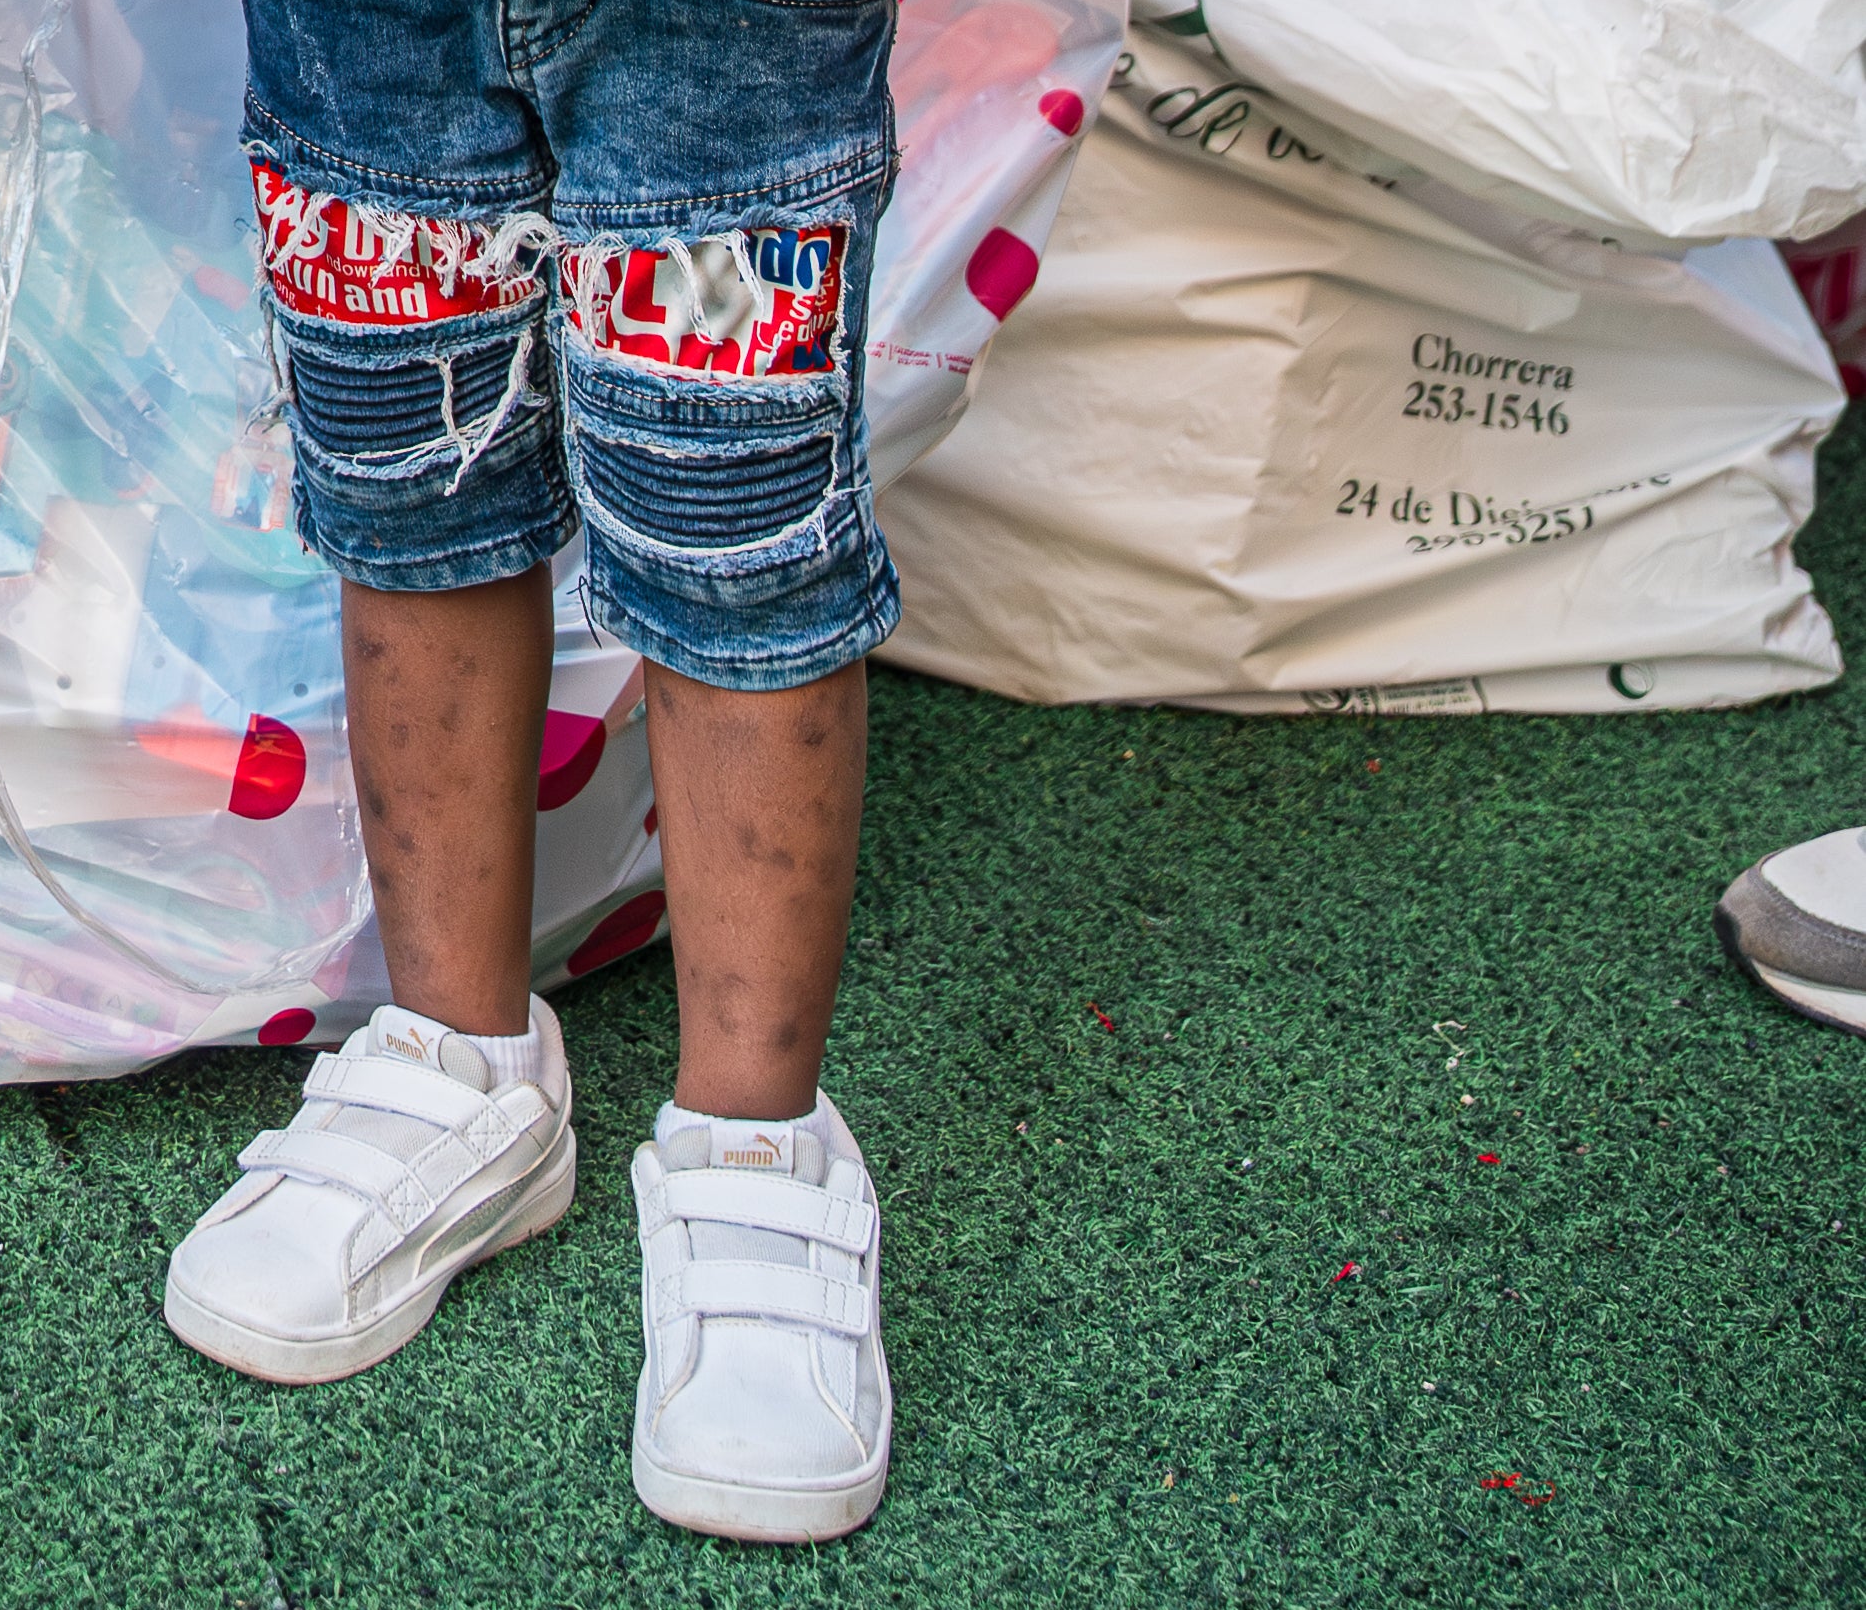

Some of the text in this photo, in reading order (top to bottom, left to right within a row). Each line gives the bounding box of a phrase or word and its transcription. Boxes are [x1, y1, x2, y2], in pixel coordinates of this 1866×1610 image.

[343, 280, 430, 320] and
[1411, 332, 1575, 391] Chorrera
[1401, 380, 1571, 436] 253-1546
[1335, 478, 1380, 518] 24
[1391, 485, 1434, 525] de
[385, 1031, 424, 1061] PUMA
[722, 1150, 774, 1167] PUMA
